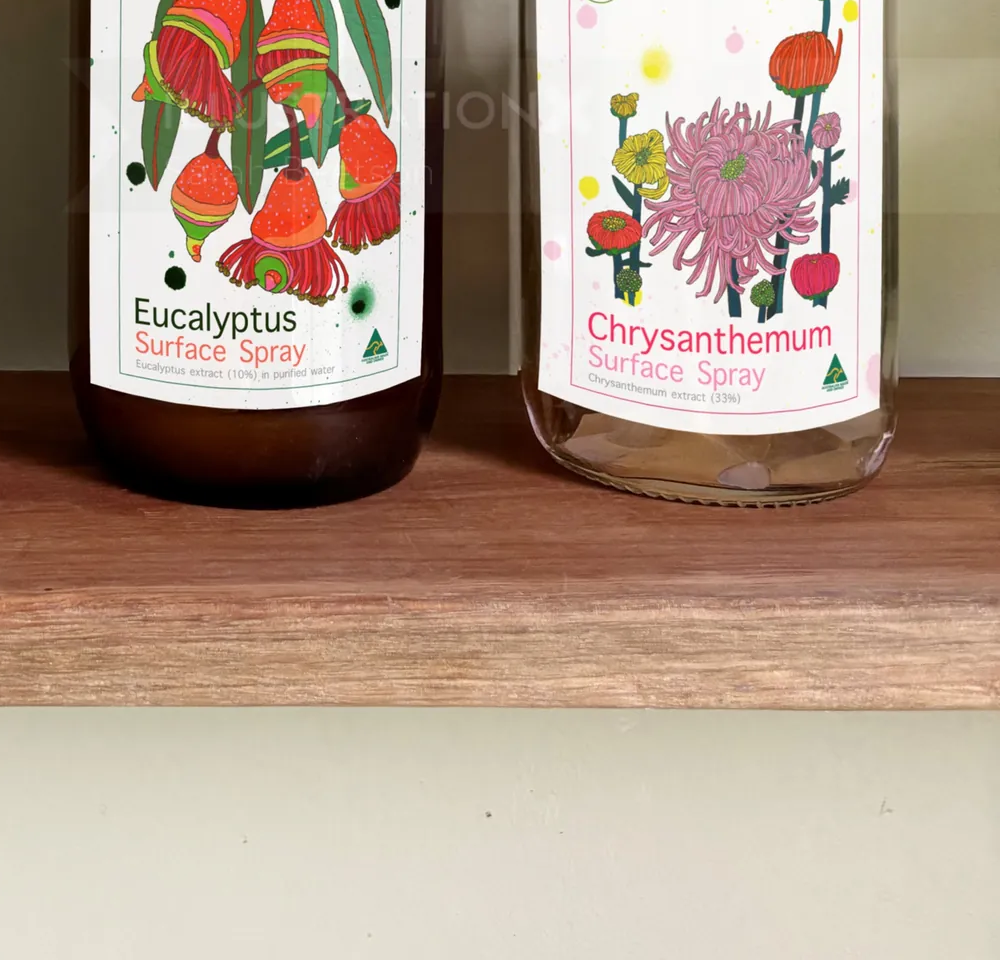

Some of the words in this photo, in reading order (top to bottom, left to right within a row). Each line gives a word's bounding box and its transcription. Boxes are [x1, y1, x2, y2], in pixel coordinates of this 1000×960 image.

[135, 297, 297, 340] Eucalyptus
[588, 311, 832, 355] Chrysanthemum
[135, 331, 226, 363] Surface
[239, 339, 306, 368] Spray
[588, 345, 683, 383] Surface
[697, 360, 766, 392] Spray
[136, 359, 186, 377] Eucalyptus
[189, 366, 224, 379] extract
[227, 368, 257, 381] (10%)
[261, 369, 270, 380] in
[273, 366, 308, 381] purified
[310, 364, 335, 377] water
[588, 372, 667, 398] Chrysanthemum
[671, 389, 706, 403] extract
[710, 392, 741, 405] (33%)
